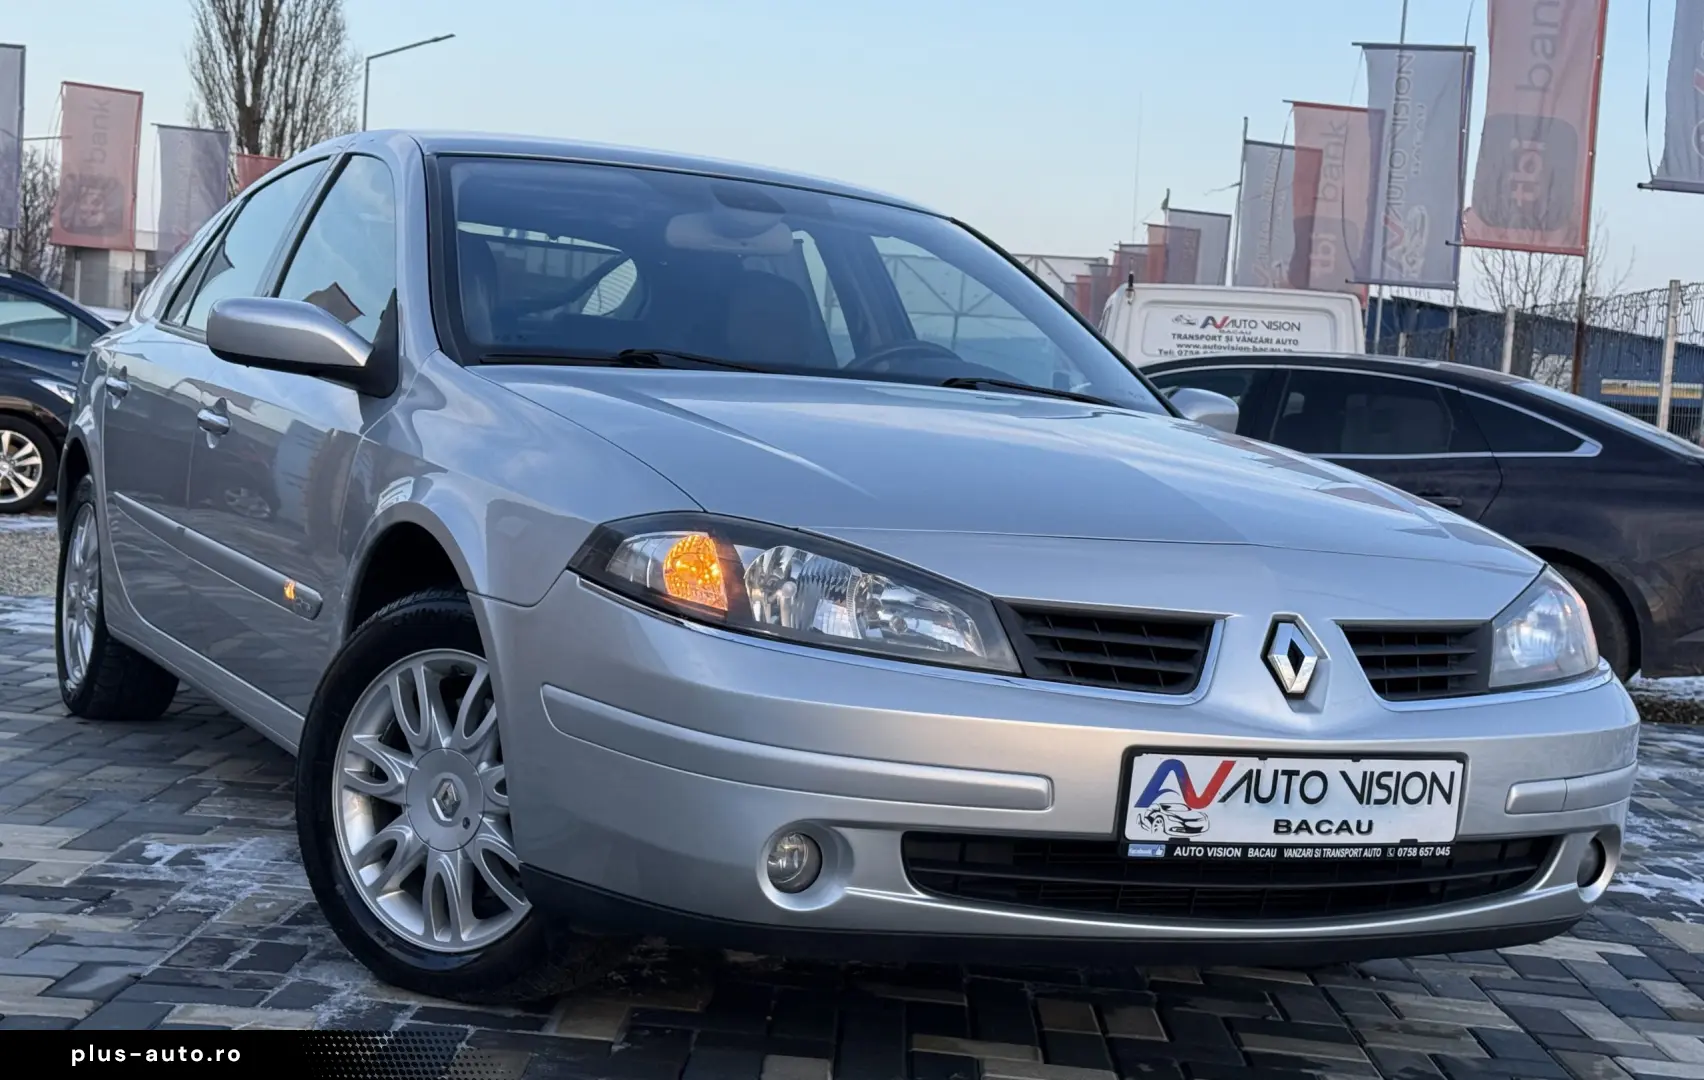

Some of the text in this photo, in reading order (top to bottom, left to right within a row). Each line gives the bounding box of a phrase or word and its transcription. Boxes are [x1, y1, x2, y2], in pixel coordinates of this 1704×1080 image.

[1390, 52, 1415, 141] VISION
[1508, 0, 1560, 207] tbi ban
[84, 98, 111, 164] bank
[1309, 119, 1347, 276] tbi bank
[1386, 149, 1408, 223] AUTO
[1171, 333, 1223, 342] TRANSPORT
[1275, 338, 1299, 346] AUTO
[1224, 319, 1258, 330] AUTO
[1261, 320, 1301, 332] VISION
[1217, 768, 1329, 805] AUTO
[1340, 770, 1456, 806] VISION
[1174, 846, 1451, 858] AUTO VISION BACAU VANZARI SI TRANSPORT AUTO 0758 657 045
[1273, 819, 1374, 836] BACAU
